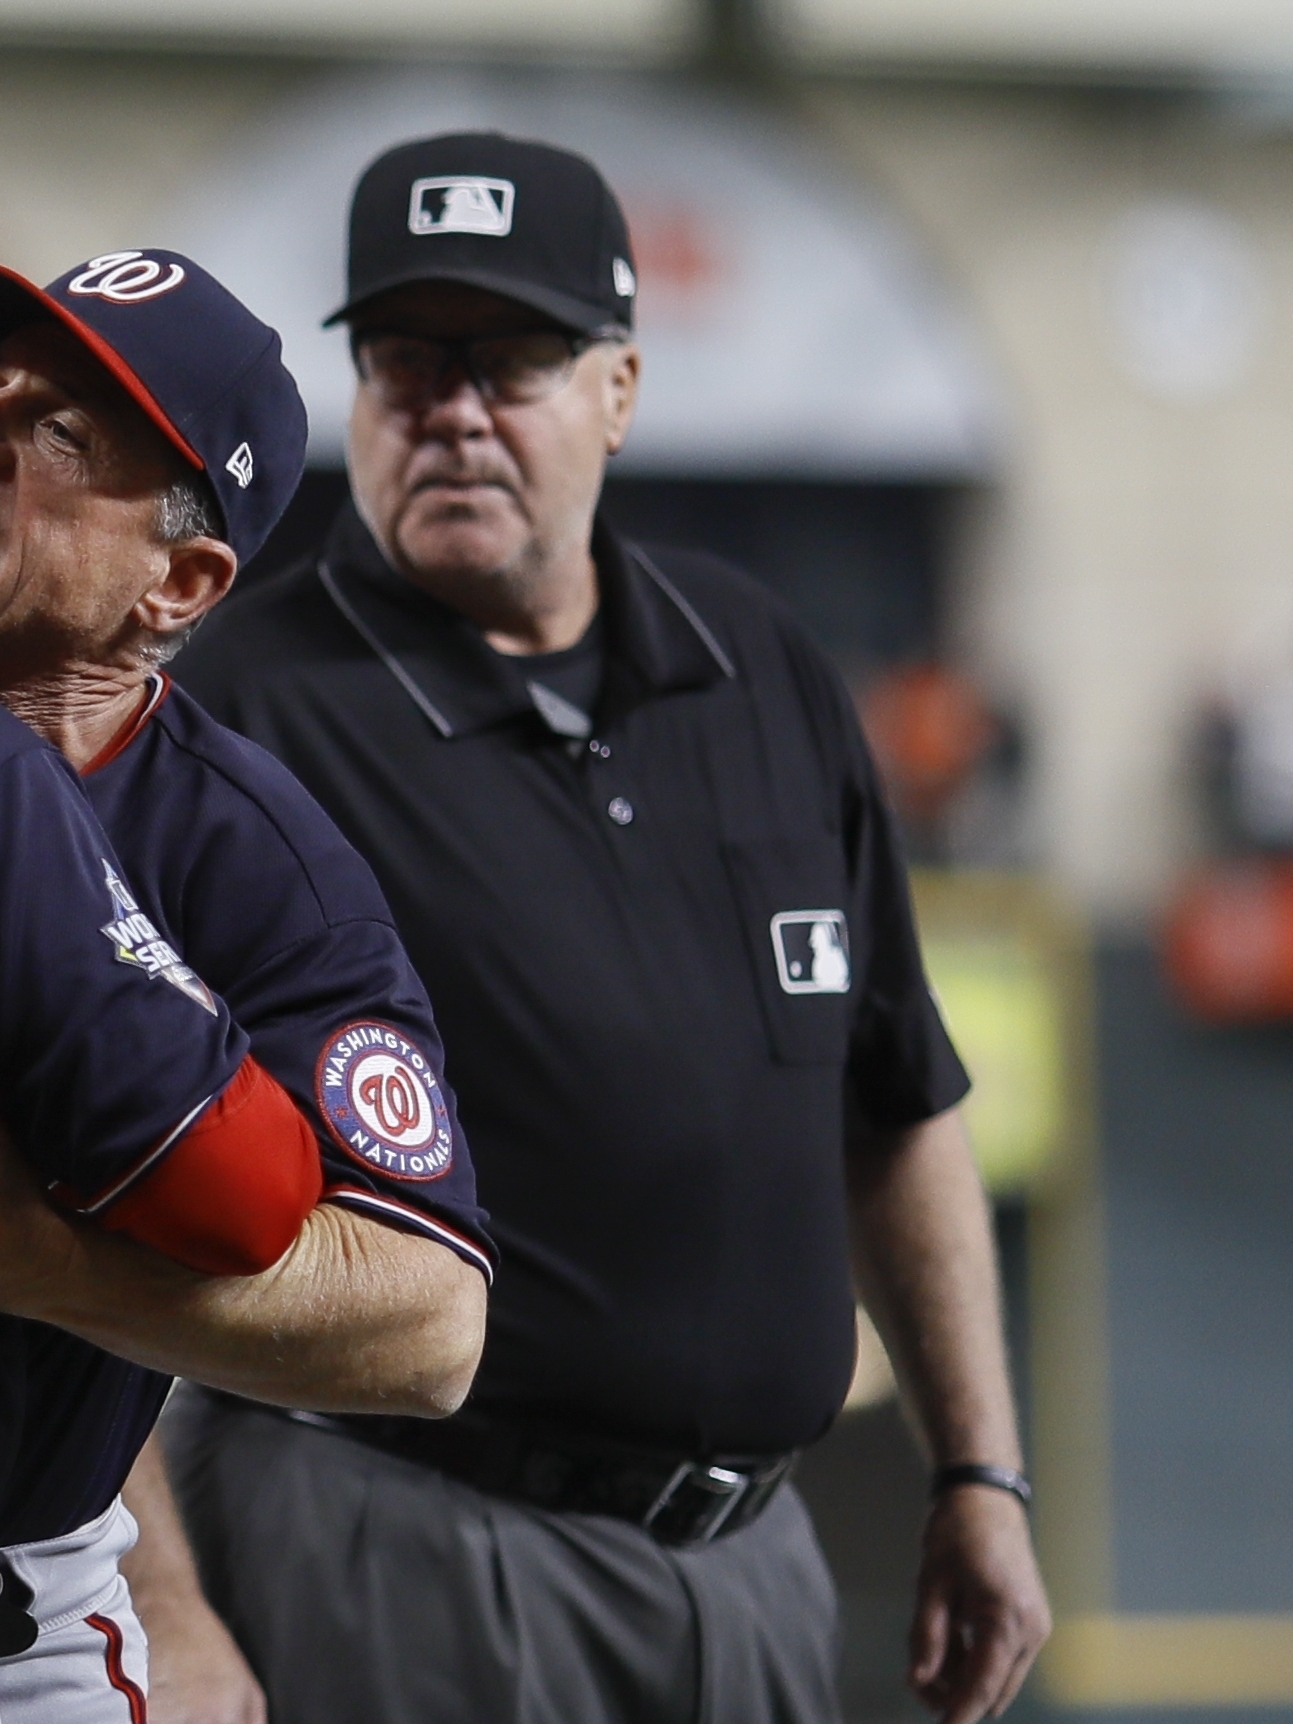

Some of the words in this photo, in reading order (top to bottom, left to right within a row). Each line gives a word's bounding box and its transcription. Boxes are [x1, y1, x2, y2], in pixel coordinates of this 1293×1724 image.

[67, 250, 185, 303] W
[326, 1028, 436, 1088] WASHINGTON
[359, 1066, 420, 1136] W
[350, 1129, 449, 1172] NATIONALS
